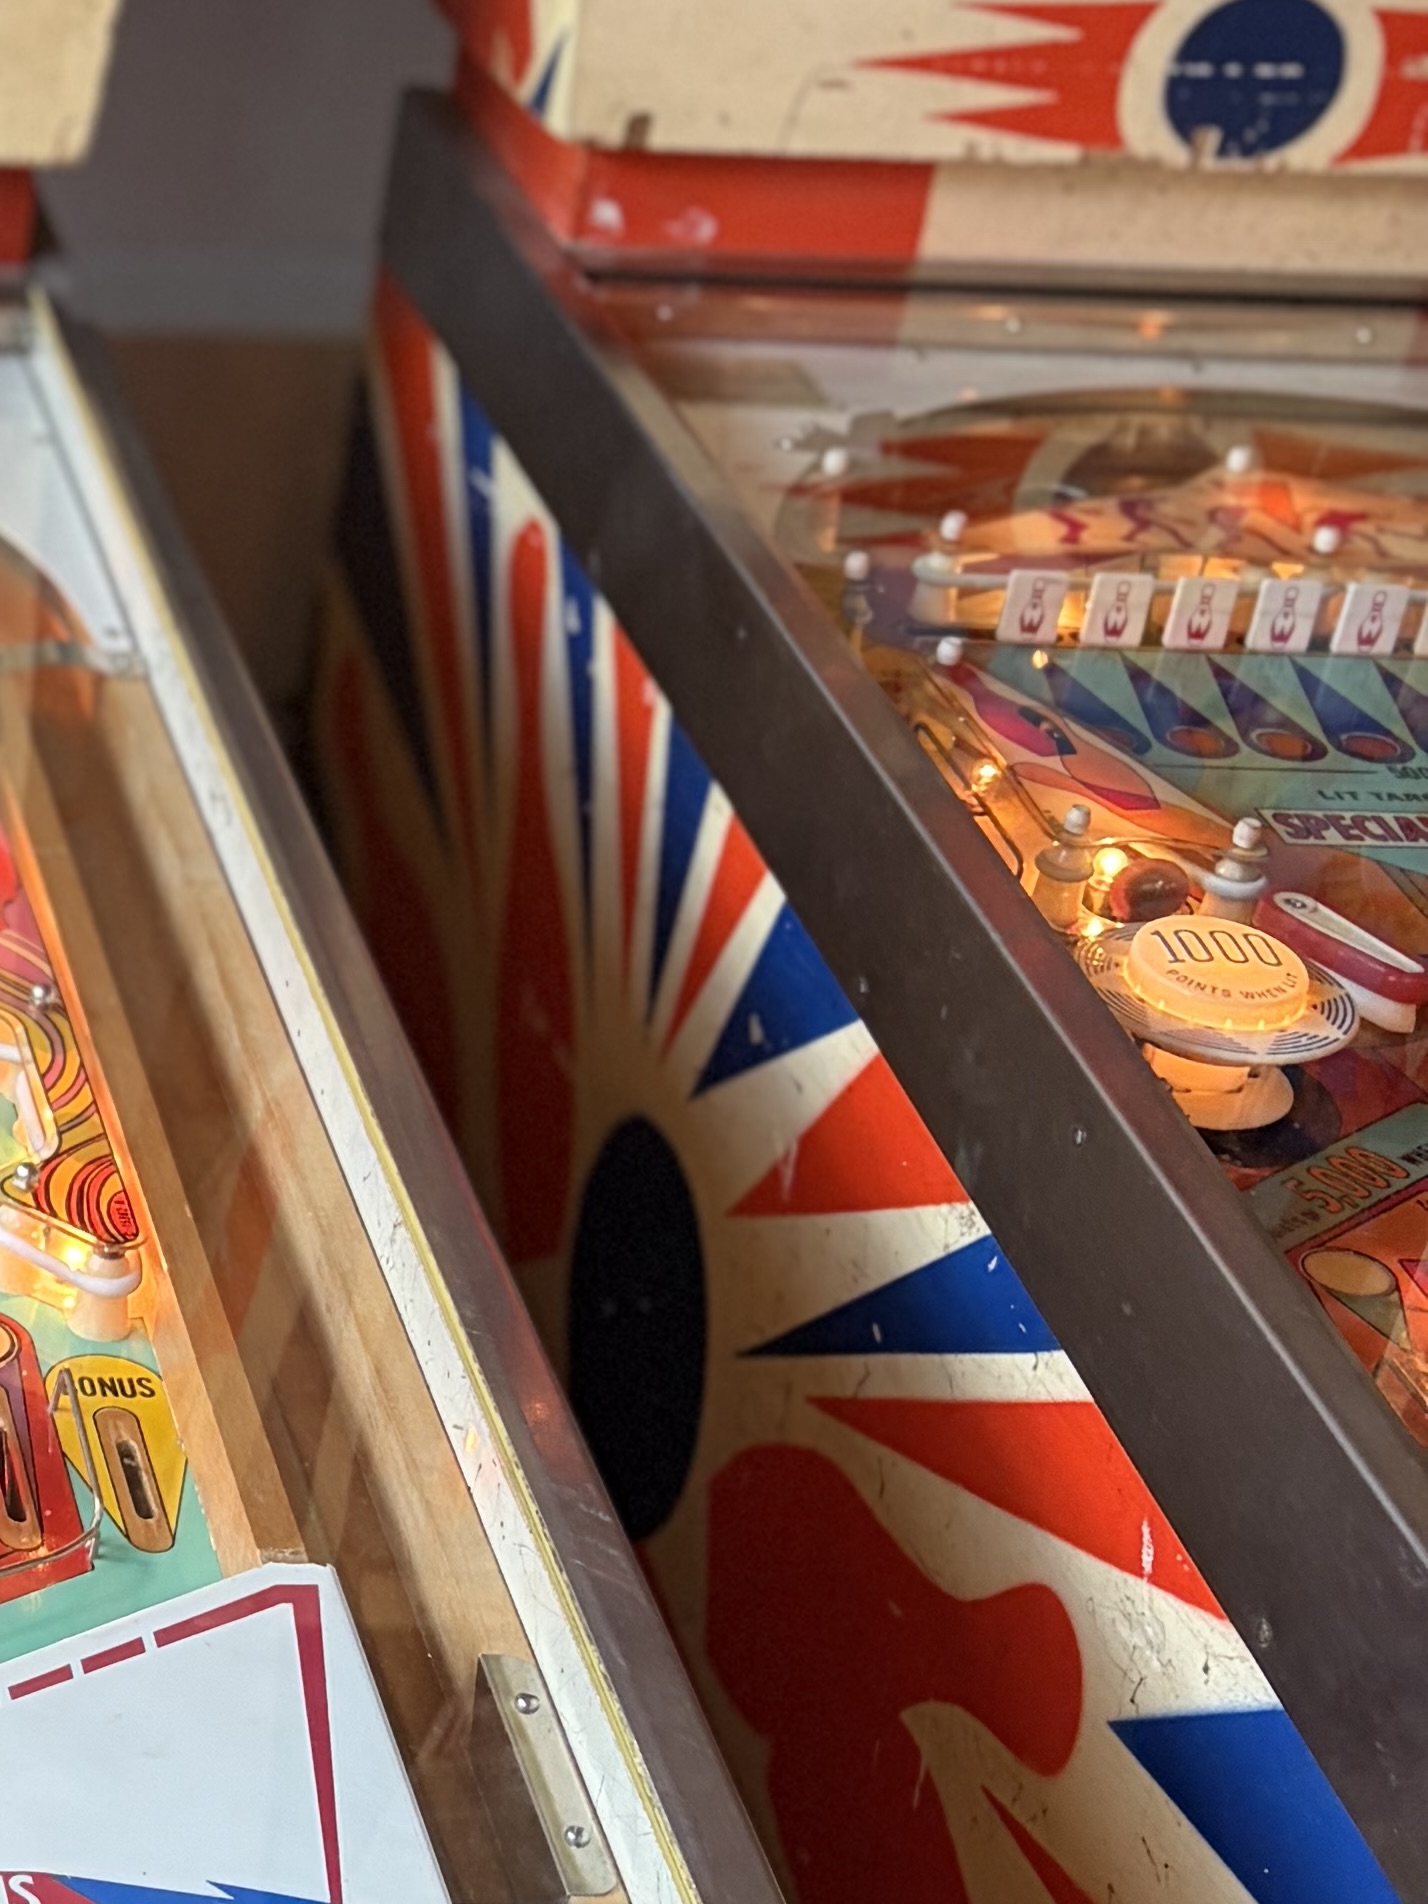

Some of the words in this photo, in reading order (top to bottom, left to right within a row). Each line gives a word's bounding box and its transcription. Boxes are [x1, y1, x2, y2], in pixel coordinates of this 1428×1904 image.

[1271, 812, 1428, 843] SPECIA
[1150, 929, 1283, 968] 1000
[1166, 969, 1232, 998] POINTS
[1239, 986, 1287, 1000] WHEN
